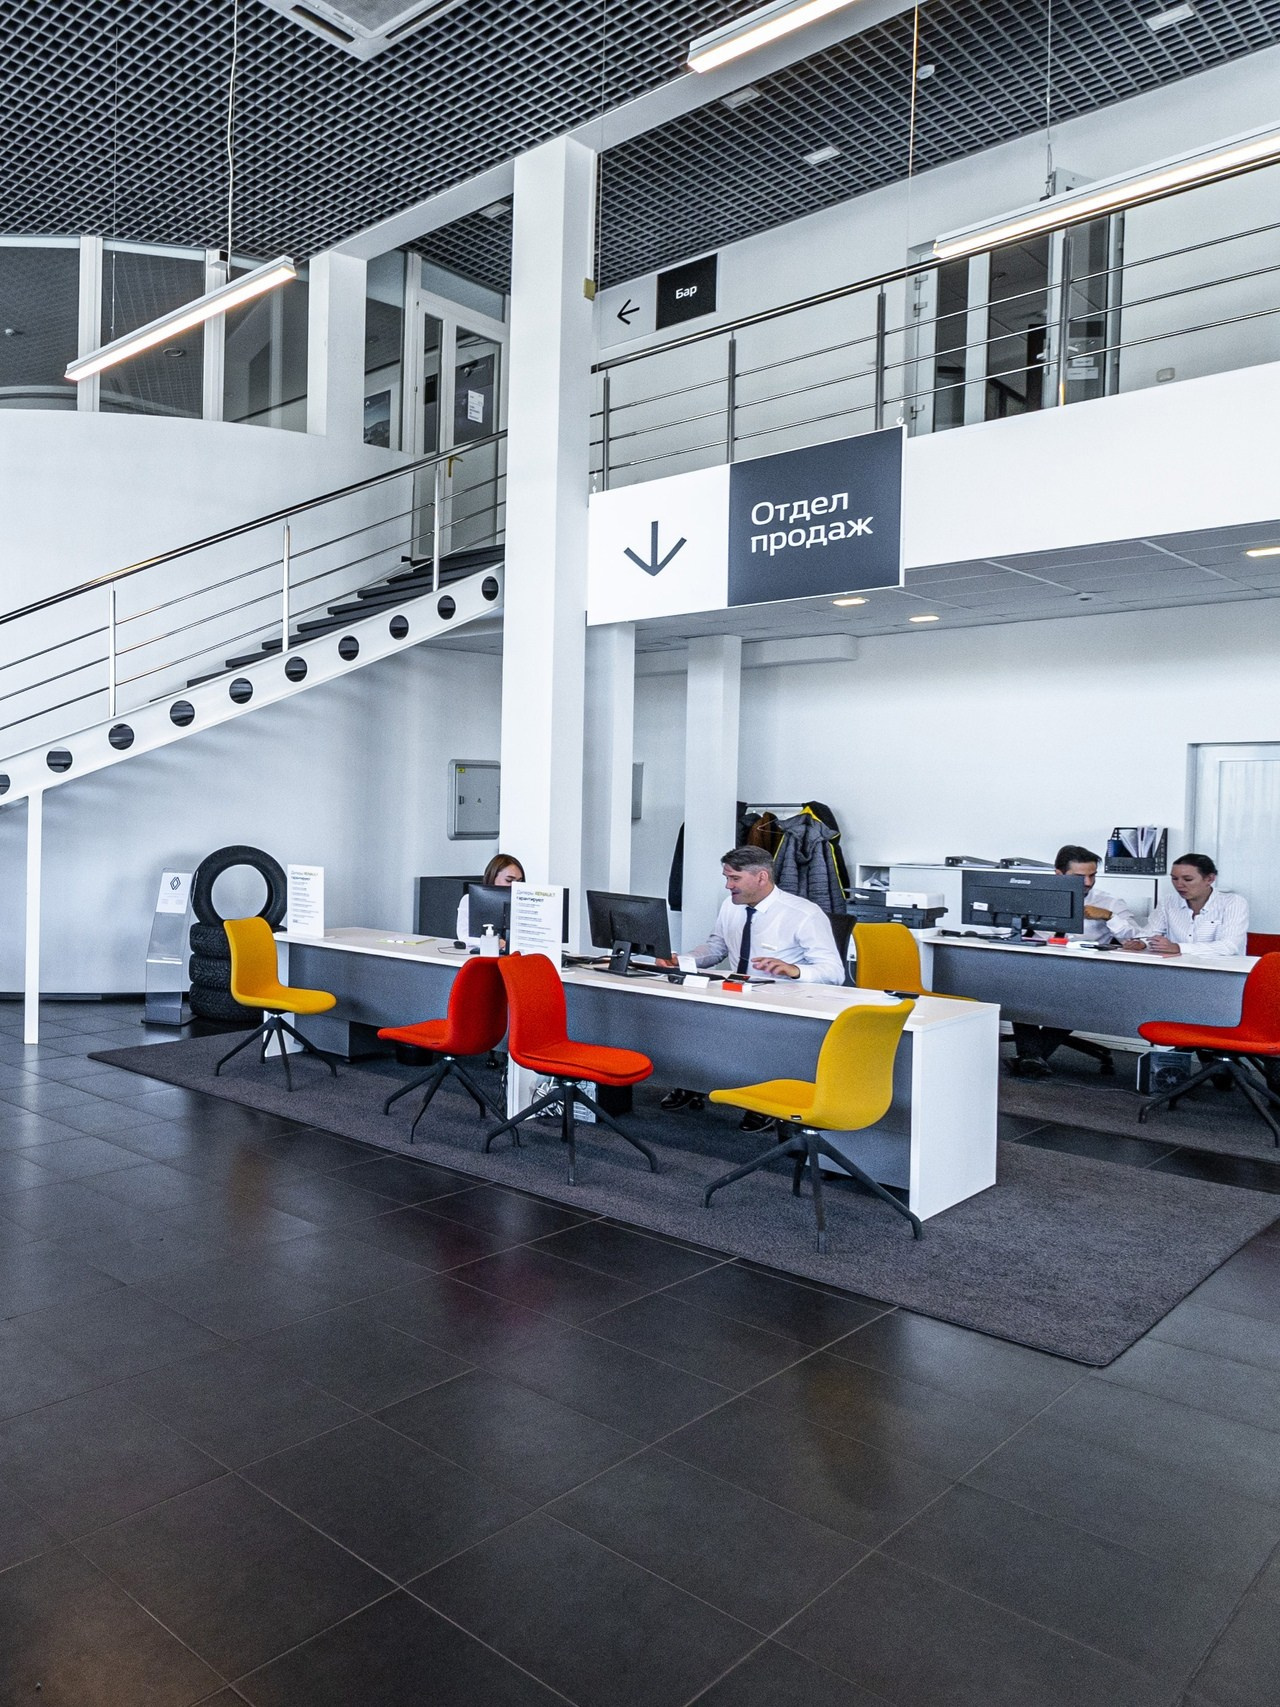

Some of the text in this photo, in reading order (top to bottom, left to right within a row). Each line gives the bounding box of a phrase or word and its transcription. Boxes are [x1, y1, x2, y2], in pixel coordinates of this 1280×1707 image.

[675, 284, 697, 299] Бар
[751, 492, 849, 525] Отдел
[751, 516, 874, 556] продаж
